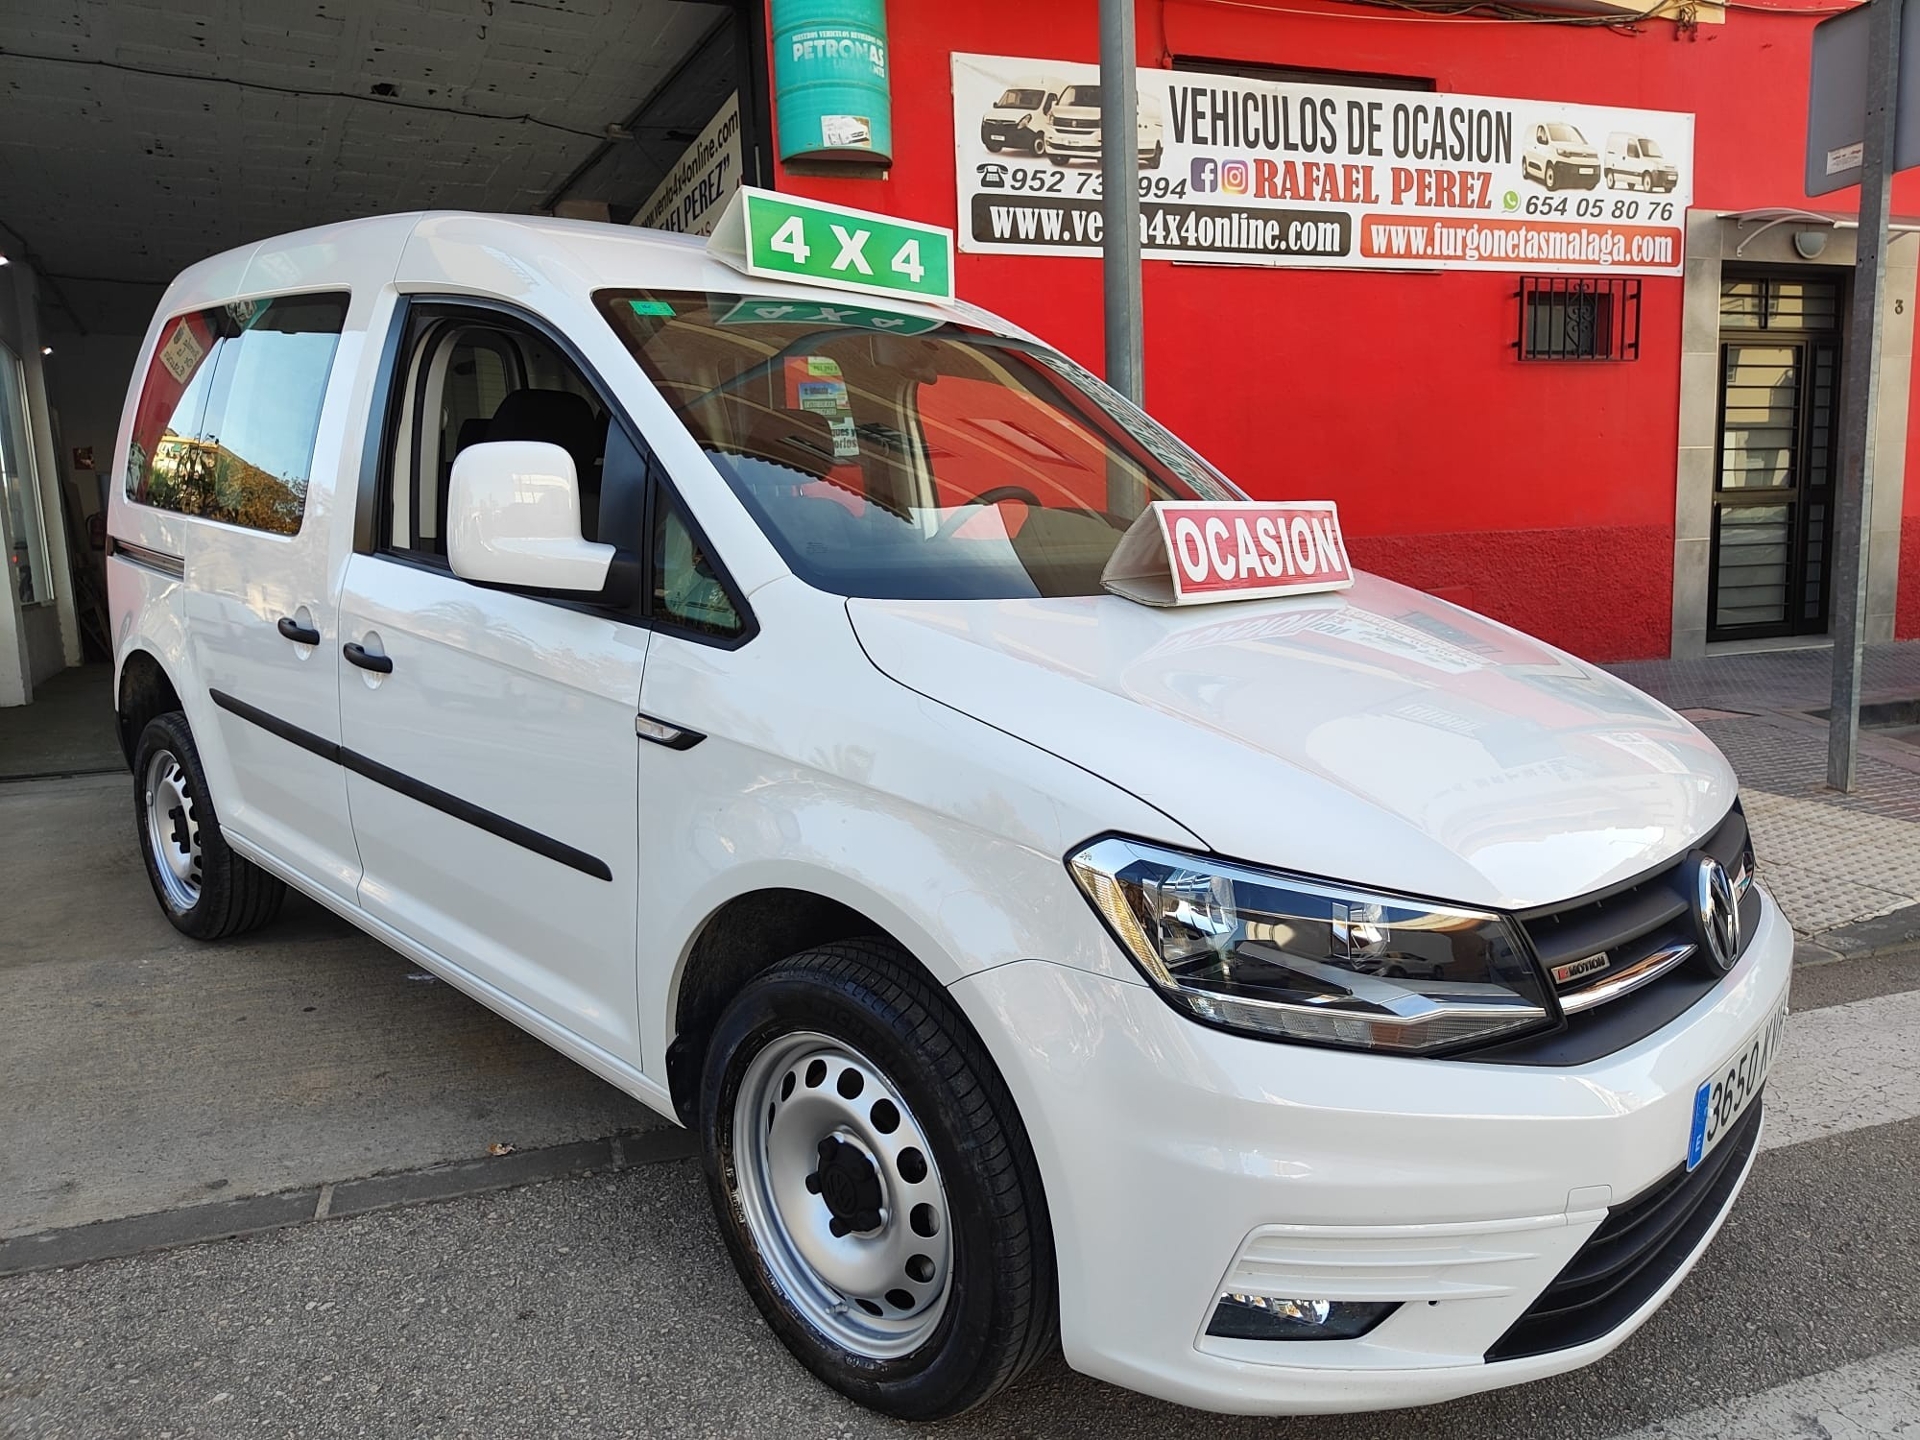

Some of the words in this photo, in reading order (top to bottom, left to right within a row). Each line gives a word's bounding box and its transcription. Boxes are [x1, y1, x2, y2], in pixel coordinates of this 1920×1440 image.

[792, 38, 884, 67] PETRONAS
[1169, 85, 1337, 154] VEHICULOS
[1347, 100, 1383, 156] DE
[1393, 103, 1512, 164] OCASION
[1010, 168, 1065, 193] 952
[1076, 172, 1104, 196] 73
[1138, 176, 1188, 200] 994
[1253, 158, 1380, 204] RAFAEL
[1391, 167, 1493, 209] PEREZ
[1525, 195, 1568, 216] 654
[1576, 198, 1604, 218] 05
[1611, 200, 1639, 220] 80
[1648, 202, 1674, 221] 76
[770, 216, 810, 264] 4
[829, 224, 874, 275] X
[891, 239, 925, 283] 4
[1370, 223, 1673, 265] www.furgonetasmalaga.com
[1894, 299, 1904, 315] 3
[1175, 516, 1343, 583] OCASION
[1706, 1040, 1759, 1142] 3650
